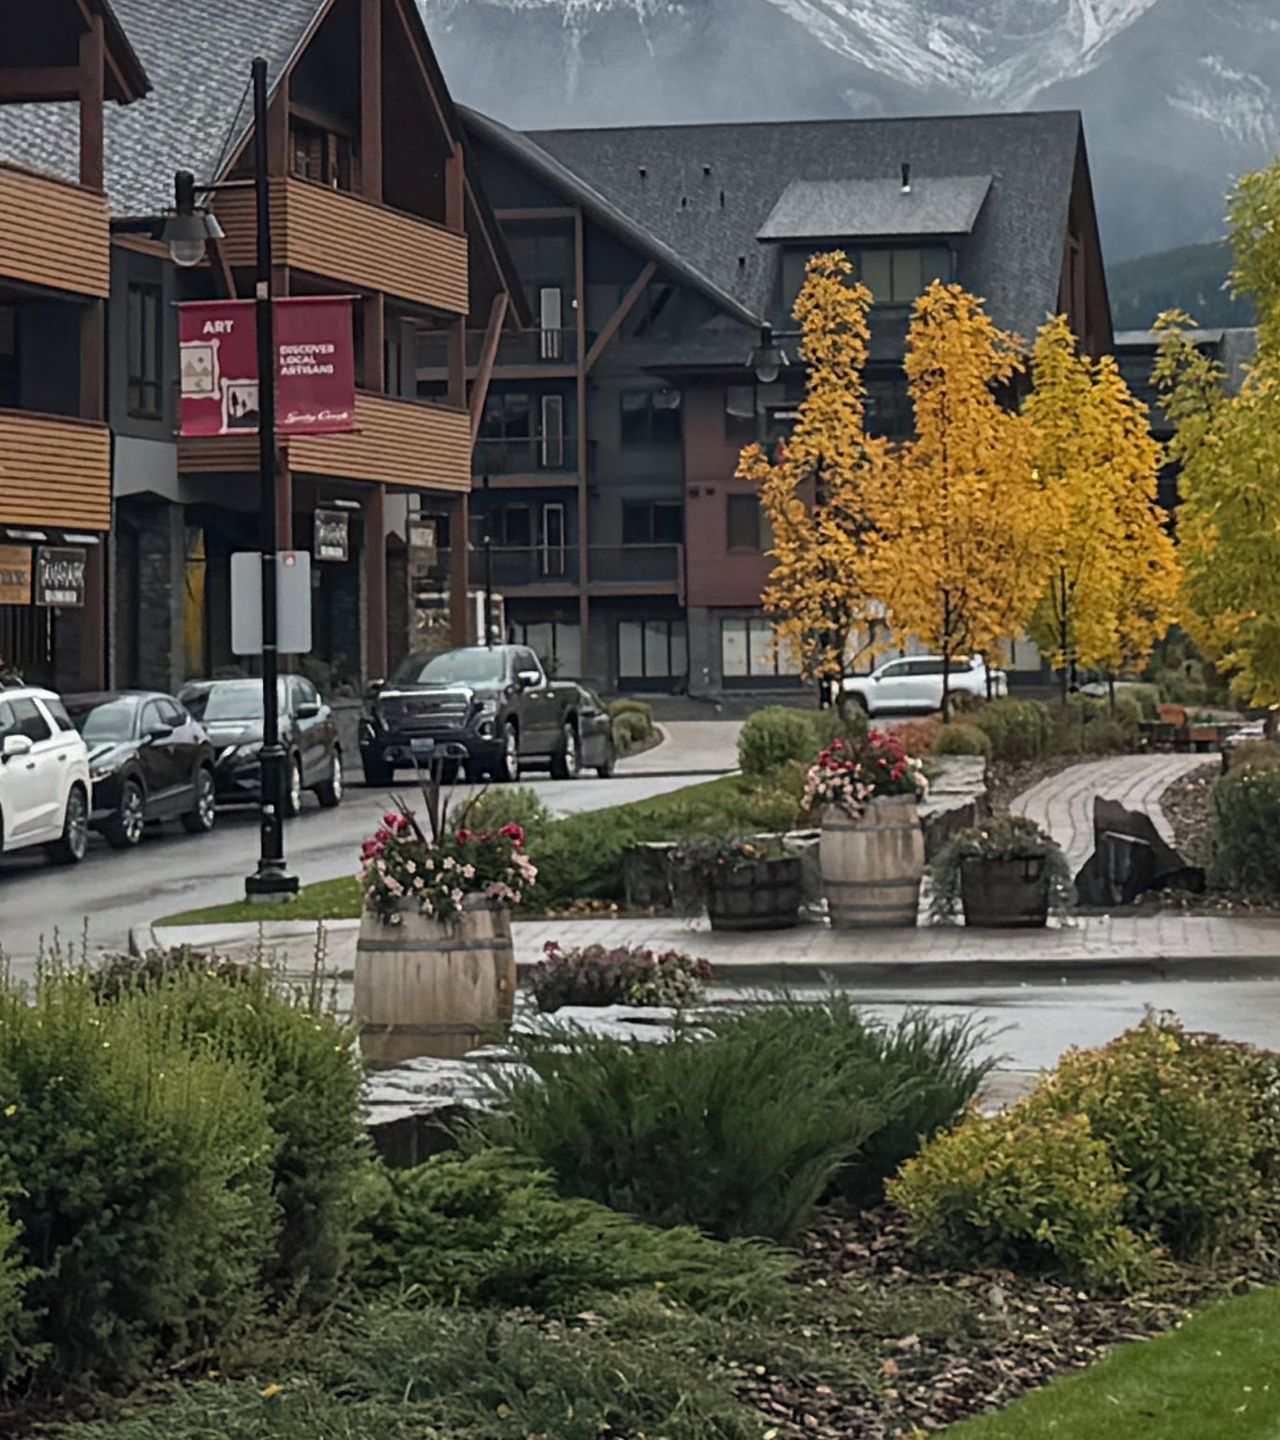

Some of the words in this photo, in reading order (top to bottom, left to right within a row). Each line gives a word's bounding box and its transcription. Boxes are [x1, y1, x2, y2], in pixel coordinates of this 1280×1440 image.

[203, 320, 234, 333] ART
[279, 344, 335, 355] DISCOVER
[280, 355, 317, 365] LOCAL
